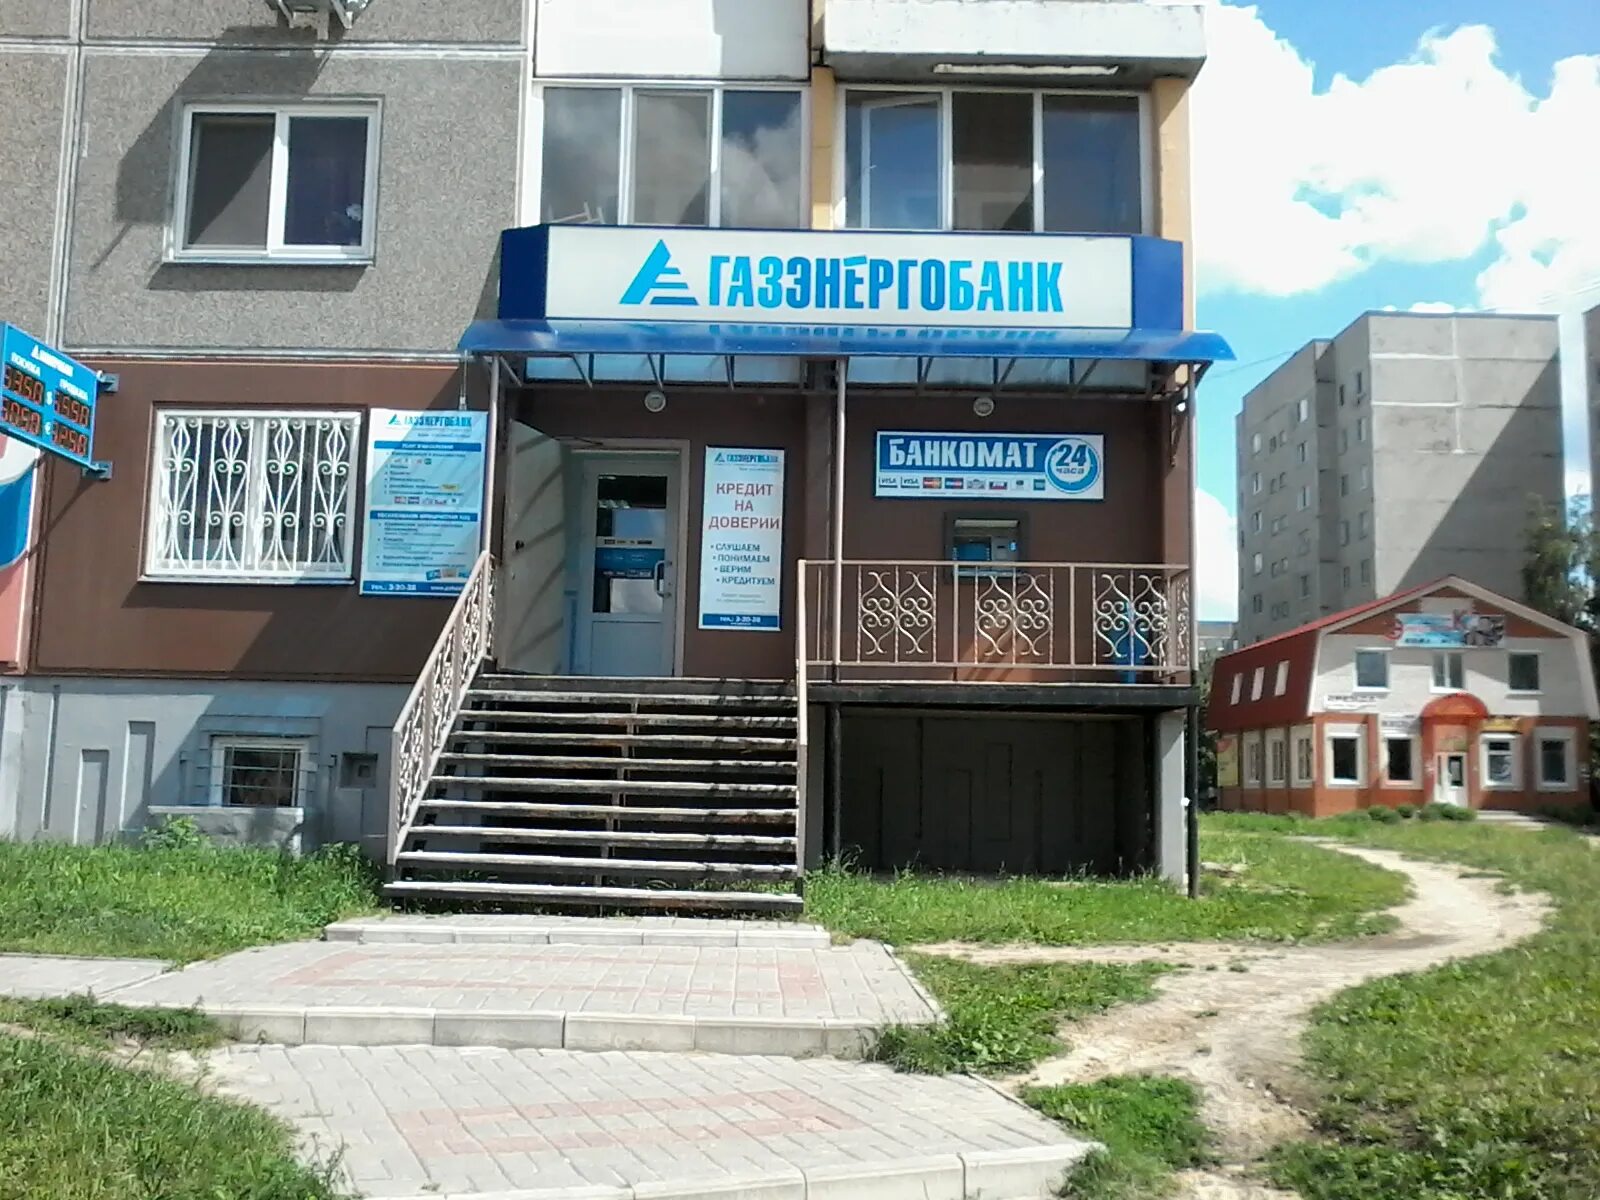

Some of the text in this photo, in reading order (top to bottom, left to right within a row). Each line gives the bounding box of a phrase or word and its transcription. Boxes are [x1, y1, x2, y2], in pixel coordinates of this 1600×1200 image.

[708, 254, 1065, 313] ГАЗЭНЕРГОБАНК
[888, 438, 1038, 469] БАНКОМАТ
[1055, 443, 1088, 467] 24
[1056, 467, 1085, 475] часа
[716, 483, 774, 496] КРЕДИТ
[734, 499, 754, 512] НА
[708, 516, 780, 530] ДОВЕРИИ
[715, 543, 760, 552] СЛУШАЕМ
[717, 554, 770, 563] ПОНИМАЕМ
[719, 565, 752, 573] ВЕРИМ
[721, 577, 776, 585] КРЕДИТУЕМ
